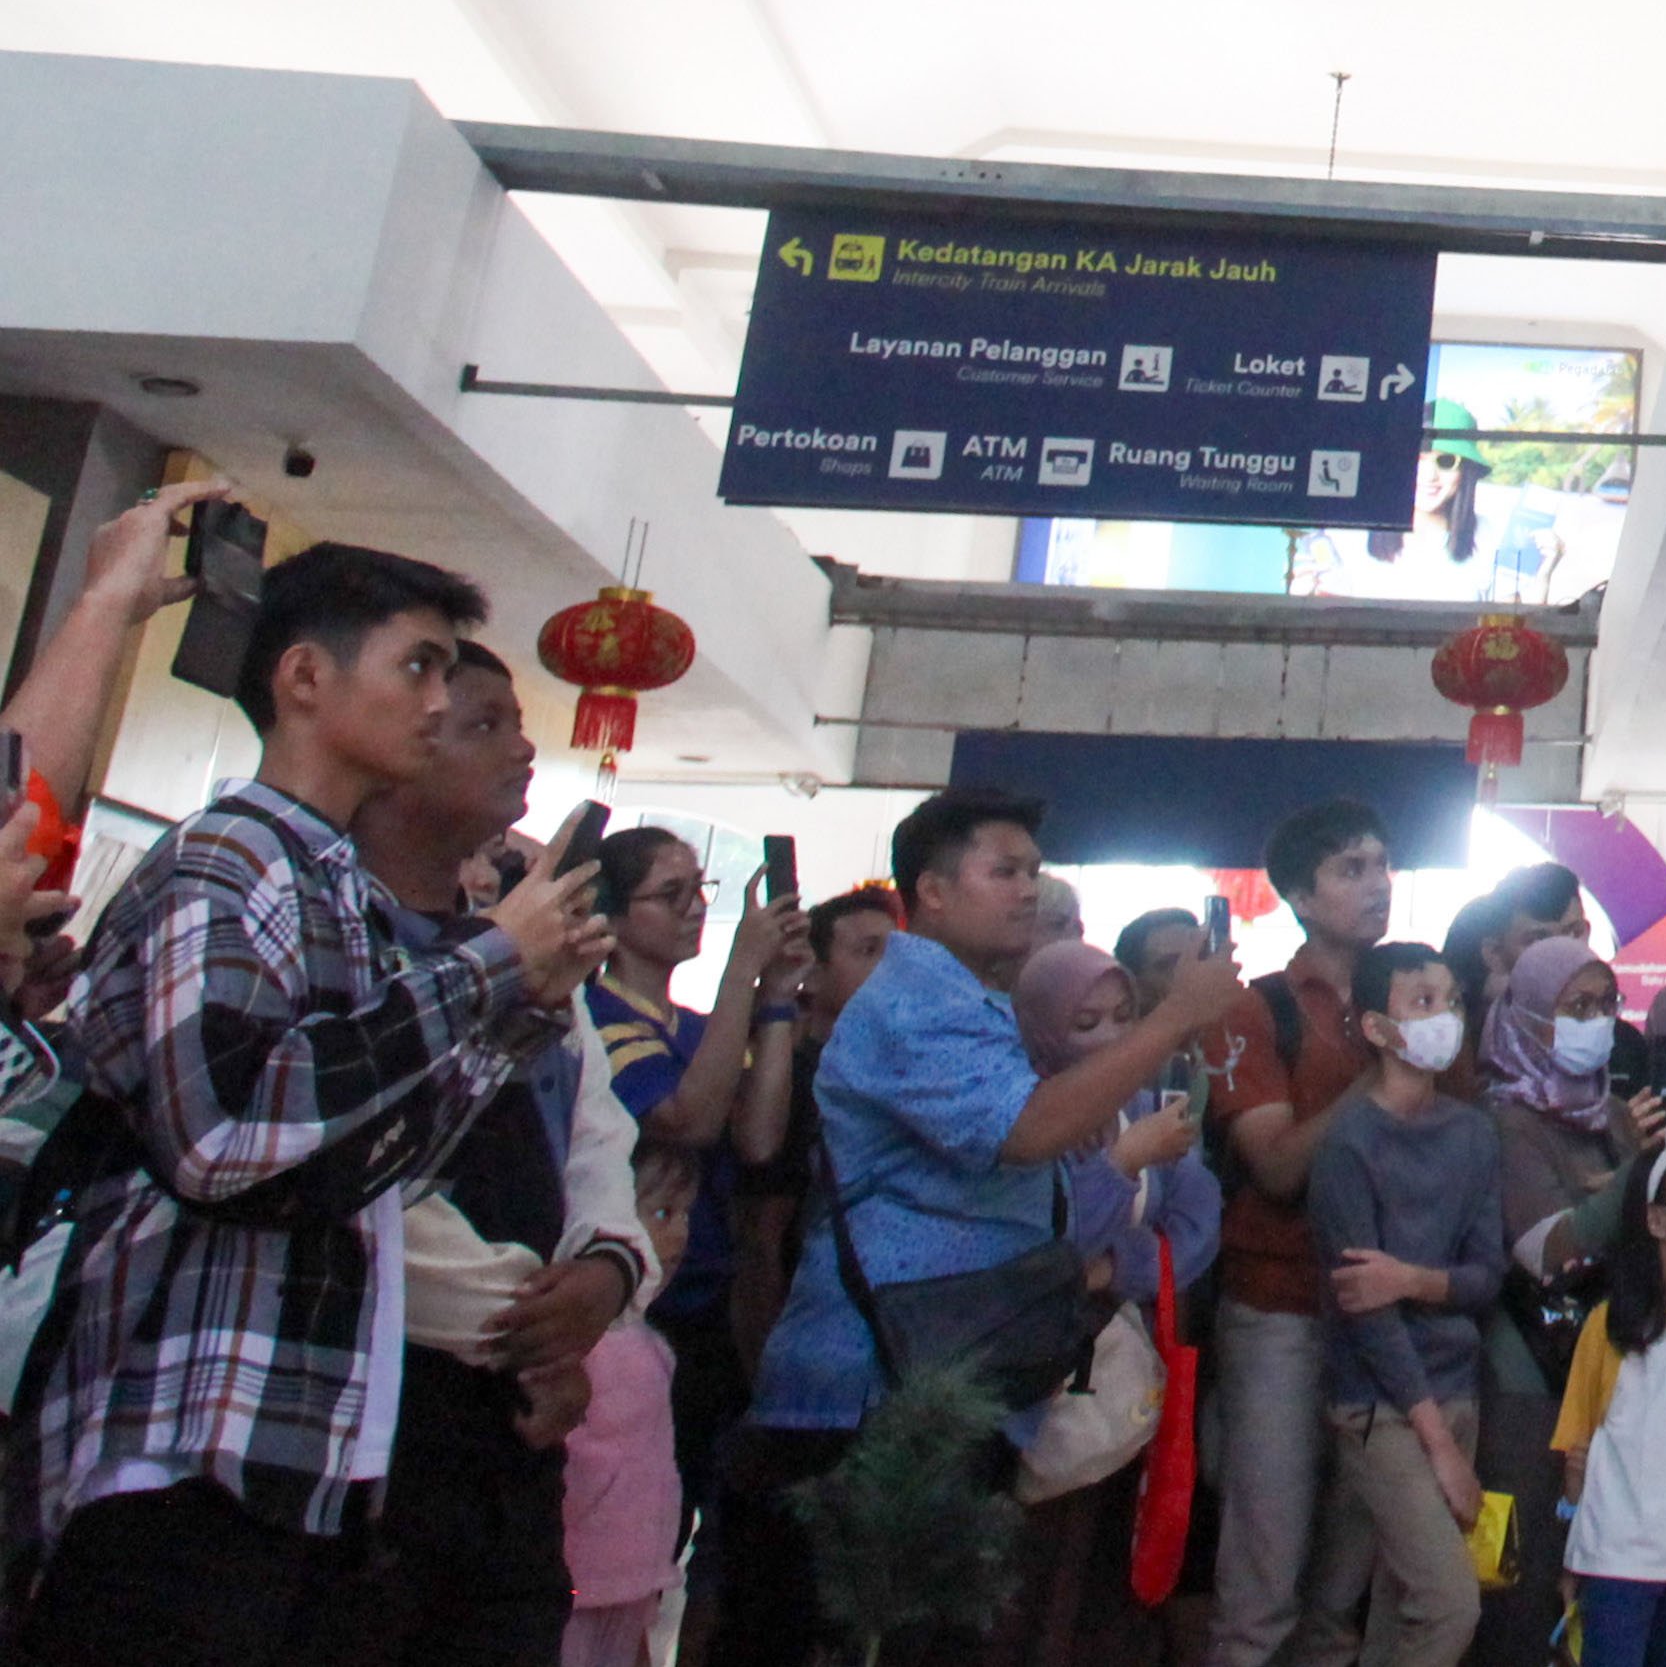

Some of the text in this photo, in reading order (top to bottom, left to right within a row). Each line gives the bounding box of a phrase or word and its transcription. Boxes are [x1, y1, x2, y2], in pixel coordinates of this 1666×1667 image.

[896, 239, 1277, 283] Kedatangan KA Jarak Jauh
[892, 270, 1107, 298] Intercity Train Arrivals
[849, 332, 1108, 369] Layanan Pelanggan
[1233, 352, 1306, 376] Loket
[956, 366, 1104, 388] Customer Service
[1185, 378, 1303, 398] Ticket Counter
[736, 424, 878, 452] Pertokoan
[962, 435, 1028, 459] ATM
[819, 457, 873, 477] Shops
[1108, 442, 1297, 476] Ruang Tunggu
[980, 464, 1024, 482] ATM
[1179, 473, 1293, 494] Waiting Room
